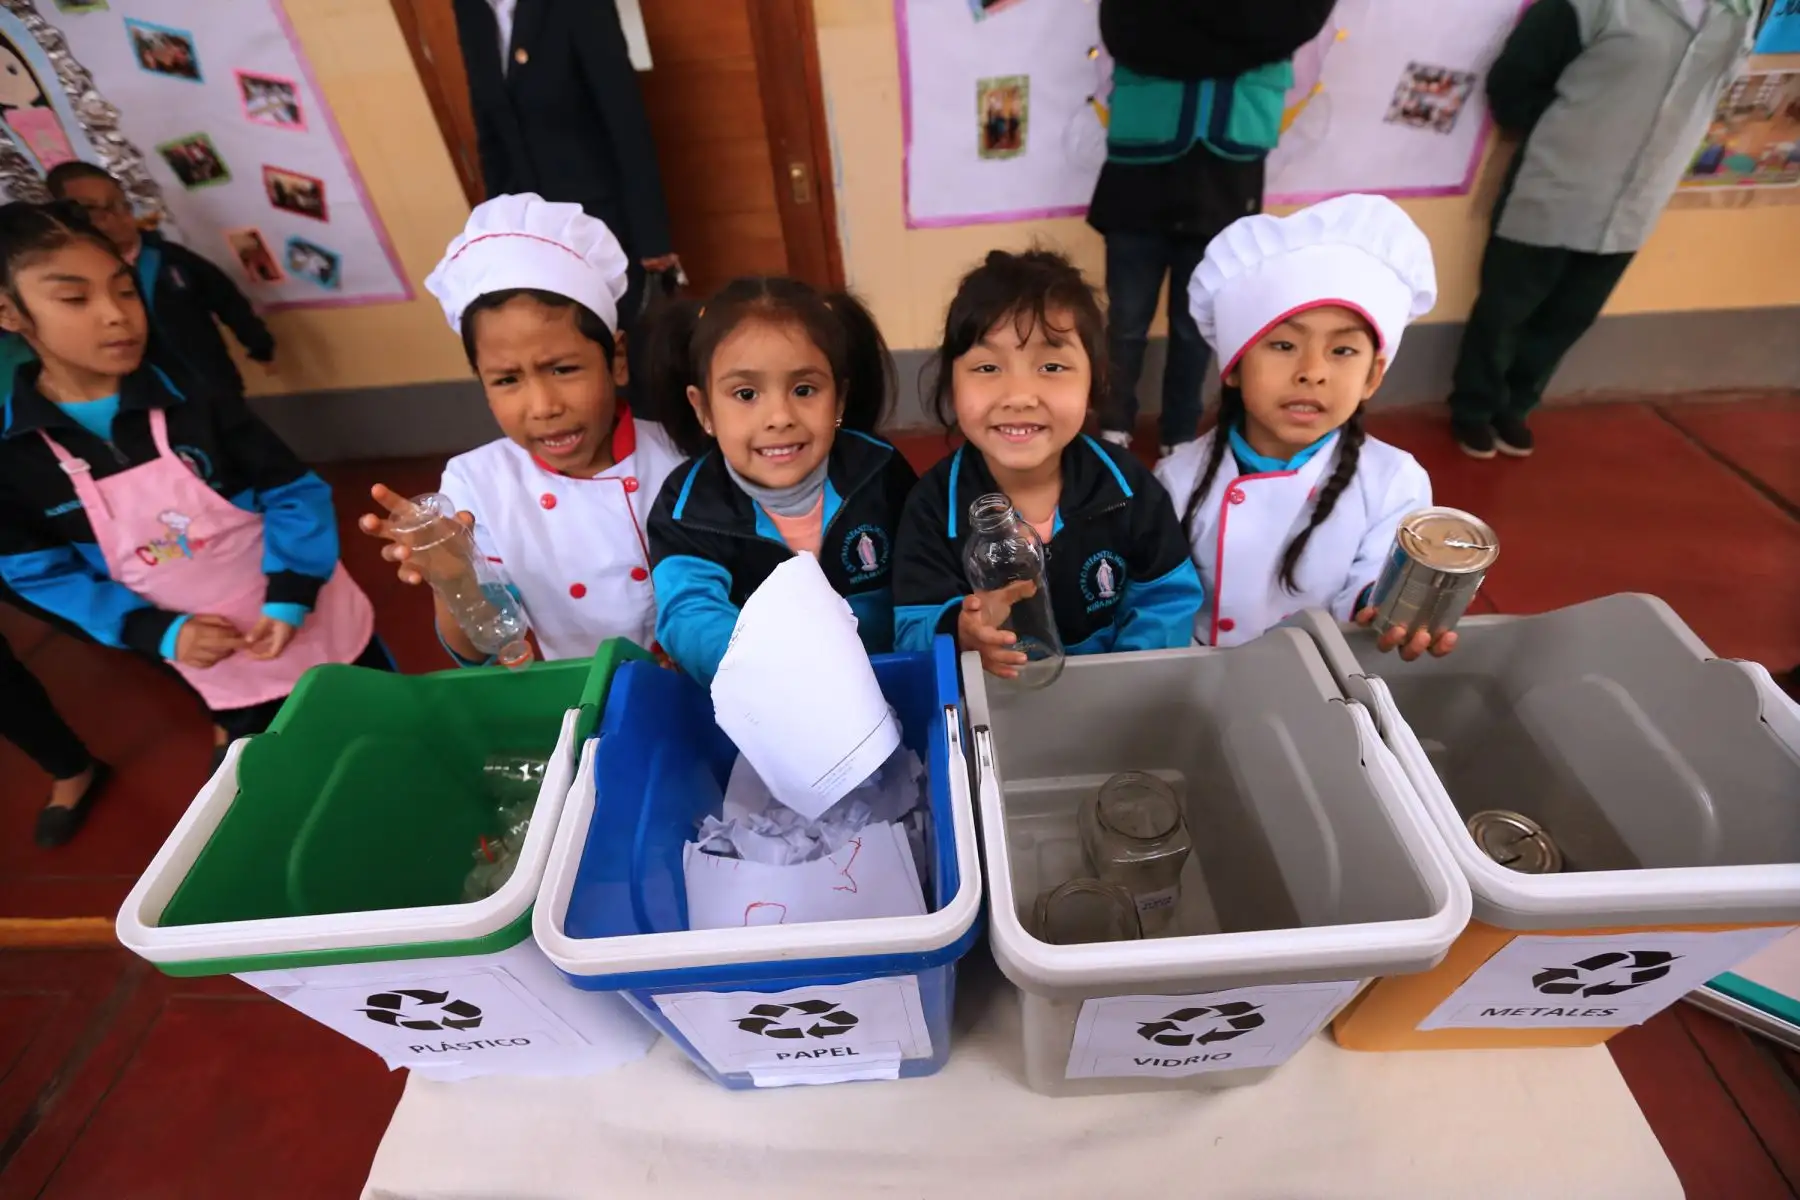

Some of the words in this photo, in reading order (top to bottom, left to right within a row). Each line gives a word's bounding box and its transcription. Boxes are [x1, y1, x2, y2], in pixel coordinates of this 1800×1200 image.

[1480, 1007, 1619, 1017] METALES
[408, 1037, 531, 1054] PLÁSTICO
[776, 1046, 860, 1060] PAPEL
[1133, 1052, 1232, 1067] VIDRIO
